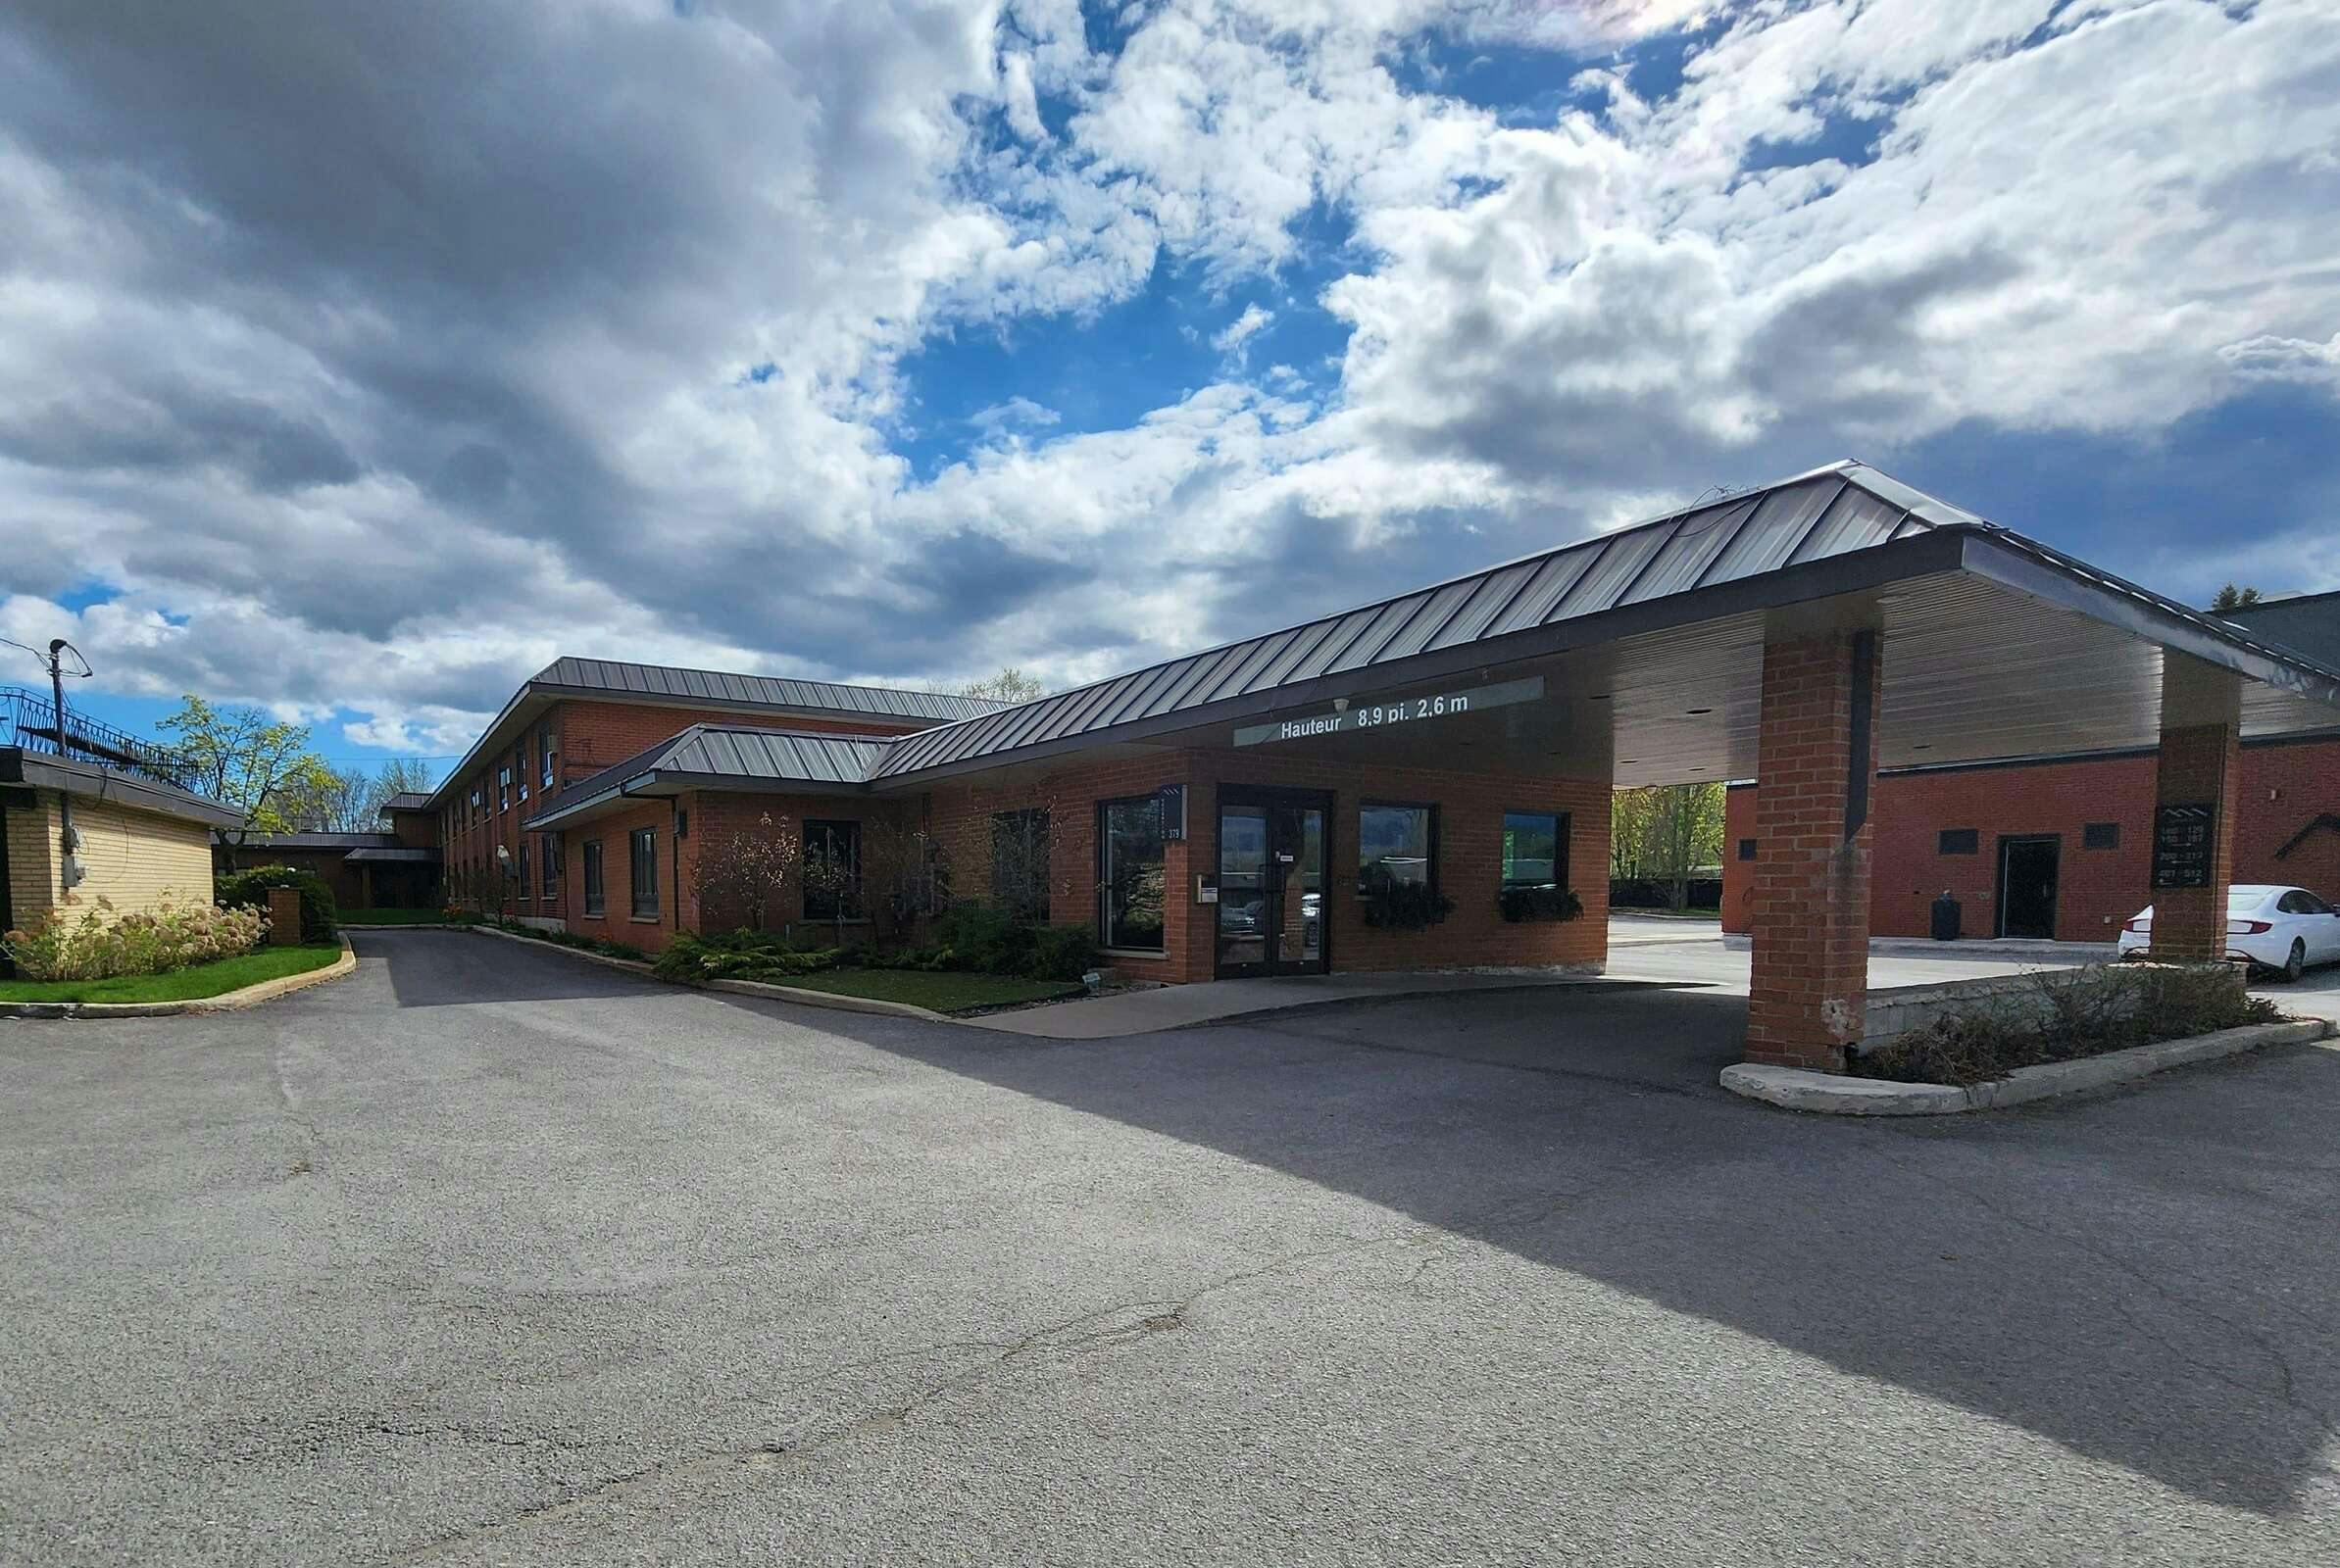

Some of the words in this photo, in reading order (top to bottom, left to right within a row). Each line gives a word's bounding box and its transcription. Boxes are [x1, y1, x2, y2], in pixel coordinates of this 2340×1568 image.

[1281, 717, 1342, 739] Hauteur
[1388, 703, 1409, 723] pi.
[1451, 696, 1468, 712] m
